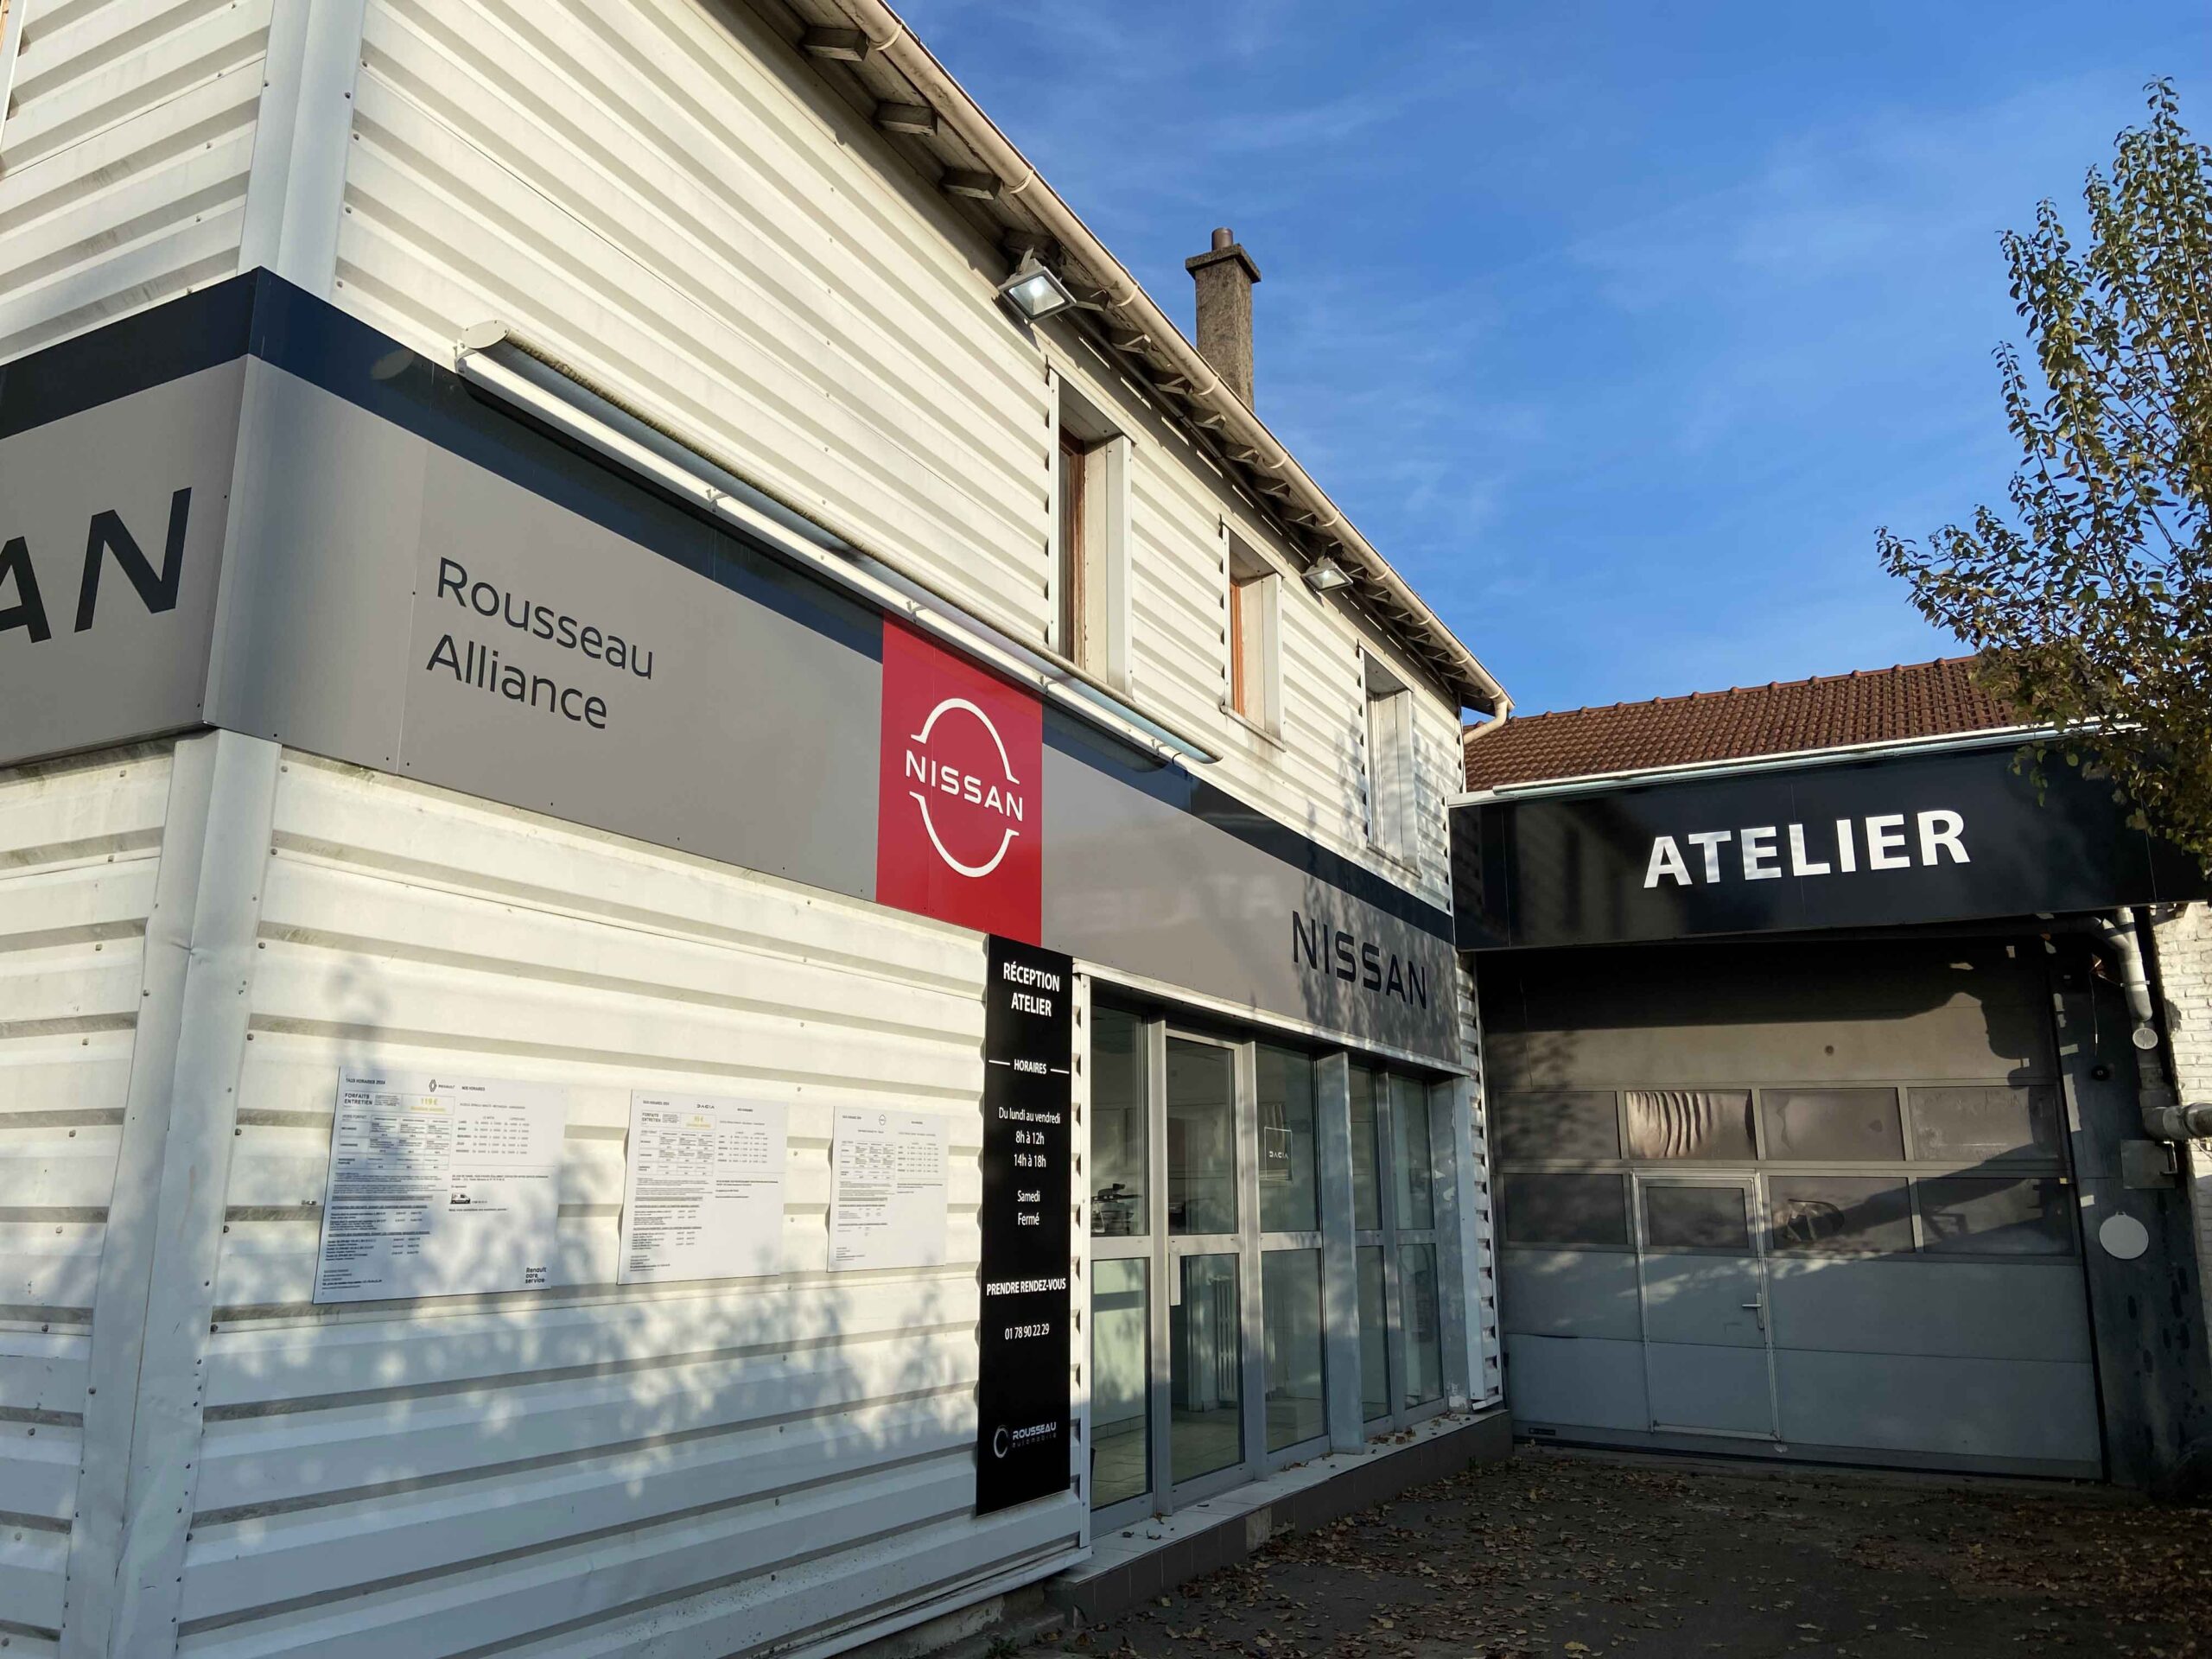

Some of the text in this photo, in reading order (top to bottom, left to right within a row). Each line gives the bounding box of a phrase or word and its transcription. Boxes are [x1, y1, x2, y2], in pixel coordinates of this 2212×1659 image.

[437, 556, 653, 680] Rousseau
[426, 633, 607, 729] Alliance
[906, 749, 1023, 822] NISSAN
[1643, 810, 1971, 888] ATELIER
[1293, 910, 1427, 1009] NISSAN
[1003, 961, 1060, 992] RÉCEPTION
[1011, 992, 1052, 1017] ATELIER
[1014, 1058, 1047, 1075] HORAIRES
[999, 1107, 1061, 1124] Du lundi au vendredi
[1015, 1130, 1045, 1145] 8h à 12h
[1014, 1154, 1046, 1167] 14h à 18h
[1268, 1150, 1289, 1160] DACIA
[1017, 1190, 1040, 1202] Samedi
[1017, 1212, 1040, 1225] Fermé
[987, 1278, 1066, 1296] PRENDRE RENDEZ-VOUS
[1005, 1323, 1050, 1340] 01 78 90 22 29
[1013, 1421, 1057, 1440] ROUSSEAU
